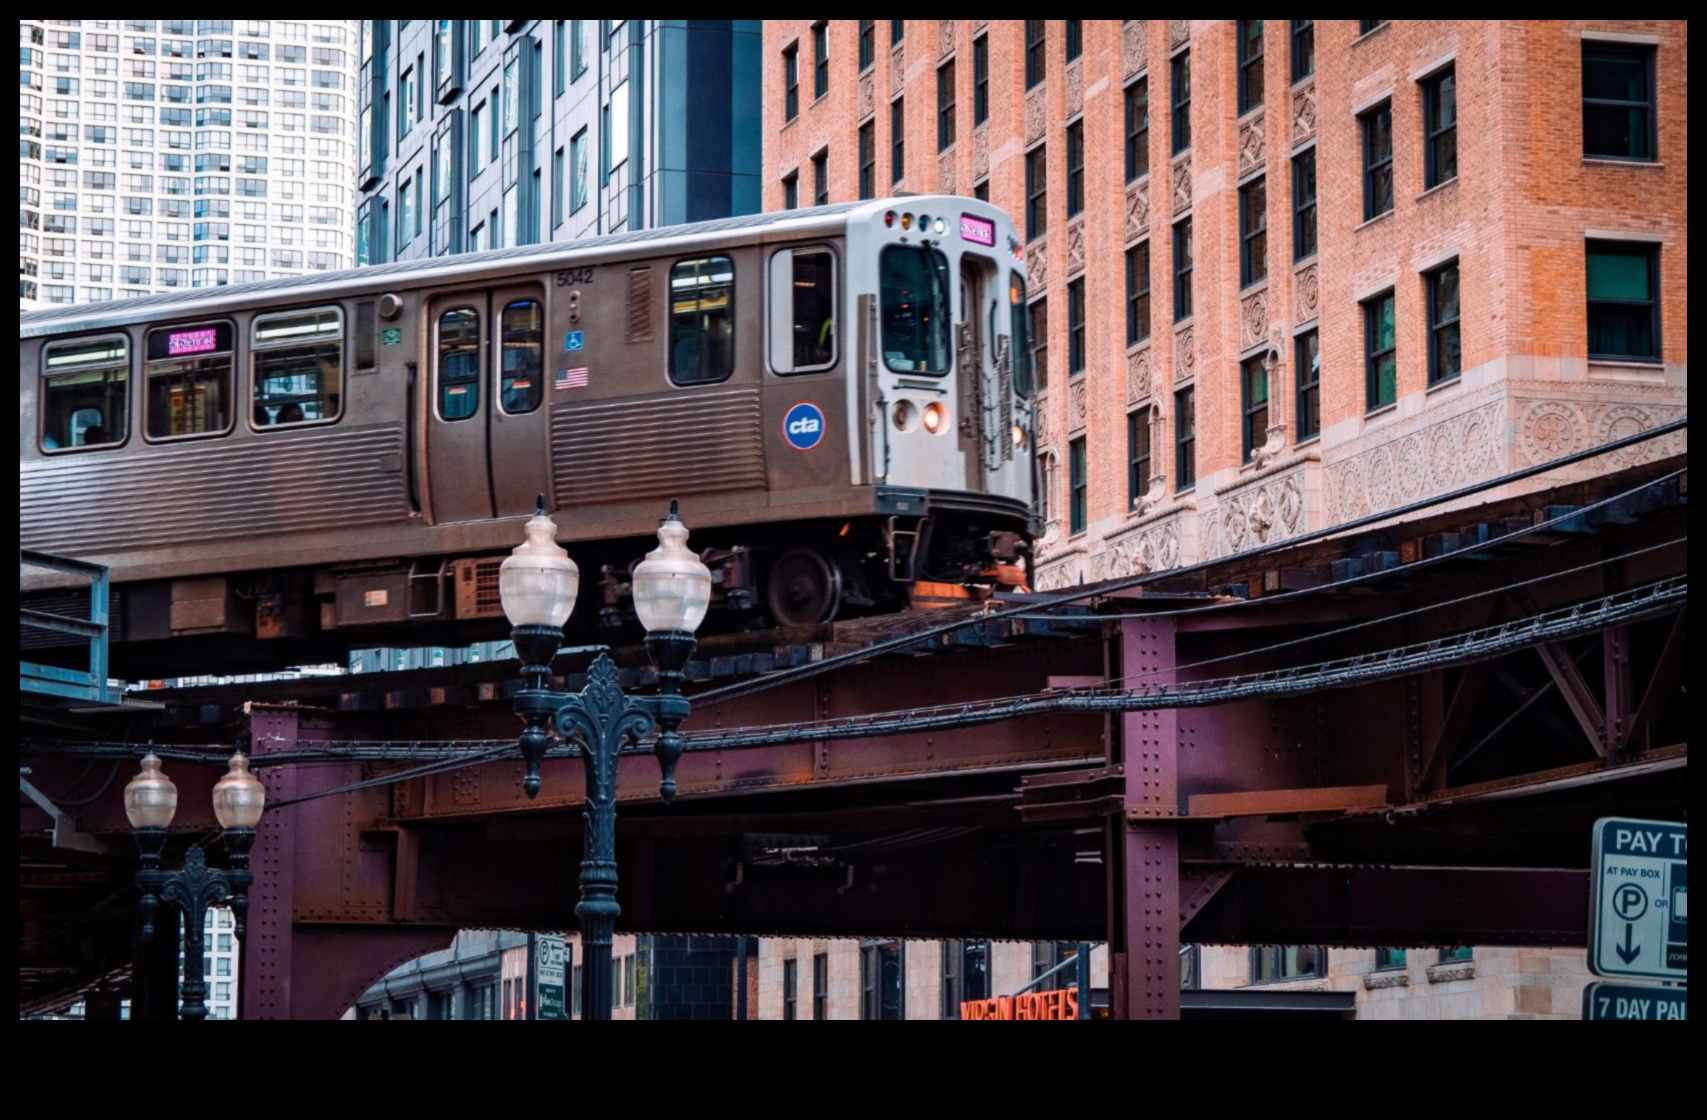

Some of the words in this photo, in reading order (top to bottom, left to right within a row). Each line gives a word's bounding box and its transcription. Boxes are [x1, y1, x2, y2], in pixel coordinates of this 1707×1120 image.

[557, 270, 593, 287] 5042
[789, 417, 819, 434] cta
[1616, 829, 1663, 853] PAY
[1669, 833, 1687, 854] T
[1607, 866, 1618, 875] AT
[1620, 867, 1638, 877] PAY
[1640, 869, 1660, 878] BOX
[1655, 899, 1668, 908] OR
[1668, 952, 1687, 961] ZON
[1599, 997, 1610, 1017] 7
[1616, 998, 1650, 1020] DAY
